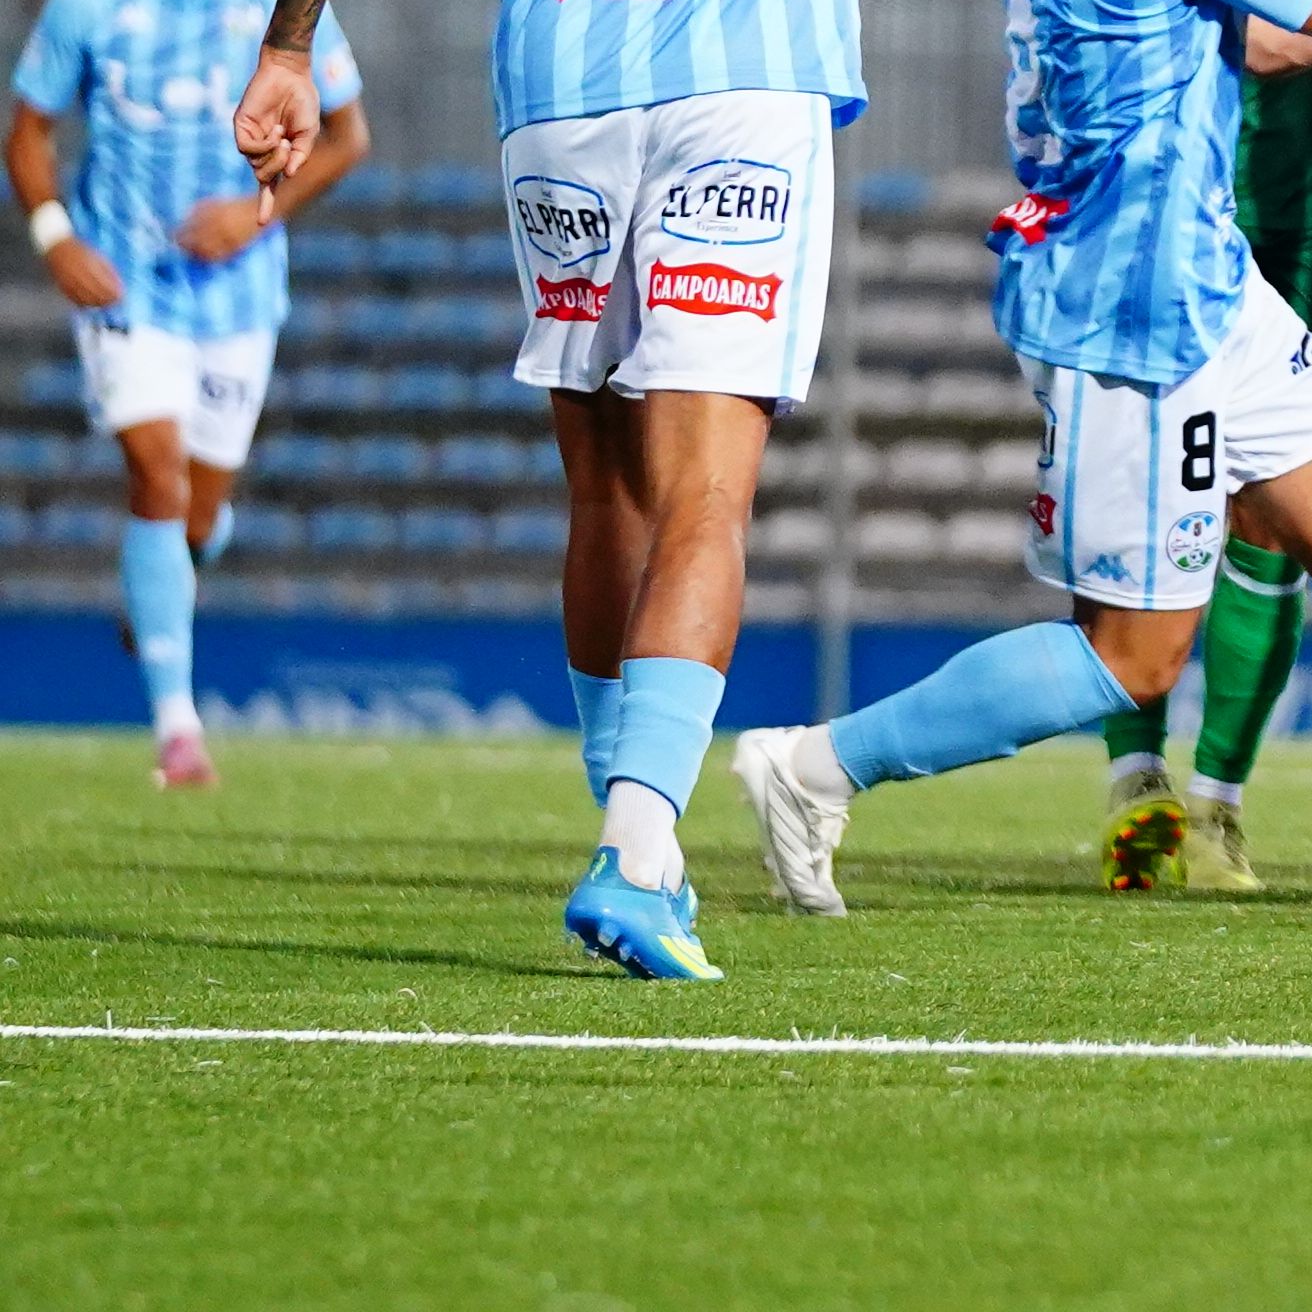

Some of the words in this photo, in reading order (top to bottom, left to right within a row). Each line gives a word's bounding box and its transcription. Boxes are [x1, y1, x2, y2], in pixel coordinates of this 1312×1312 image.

[536, 202, 611, 244] PERRI
[696, 184, 791, 224] PERRI
[651, 274, 771, 311] CAMPOARAS
[1181, 410, 1217, 492] 8
